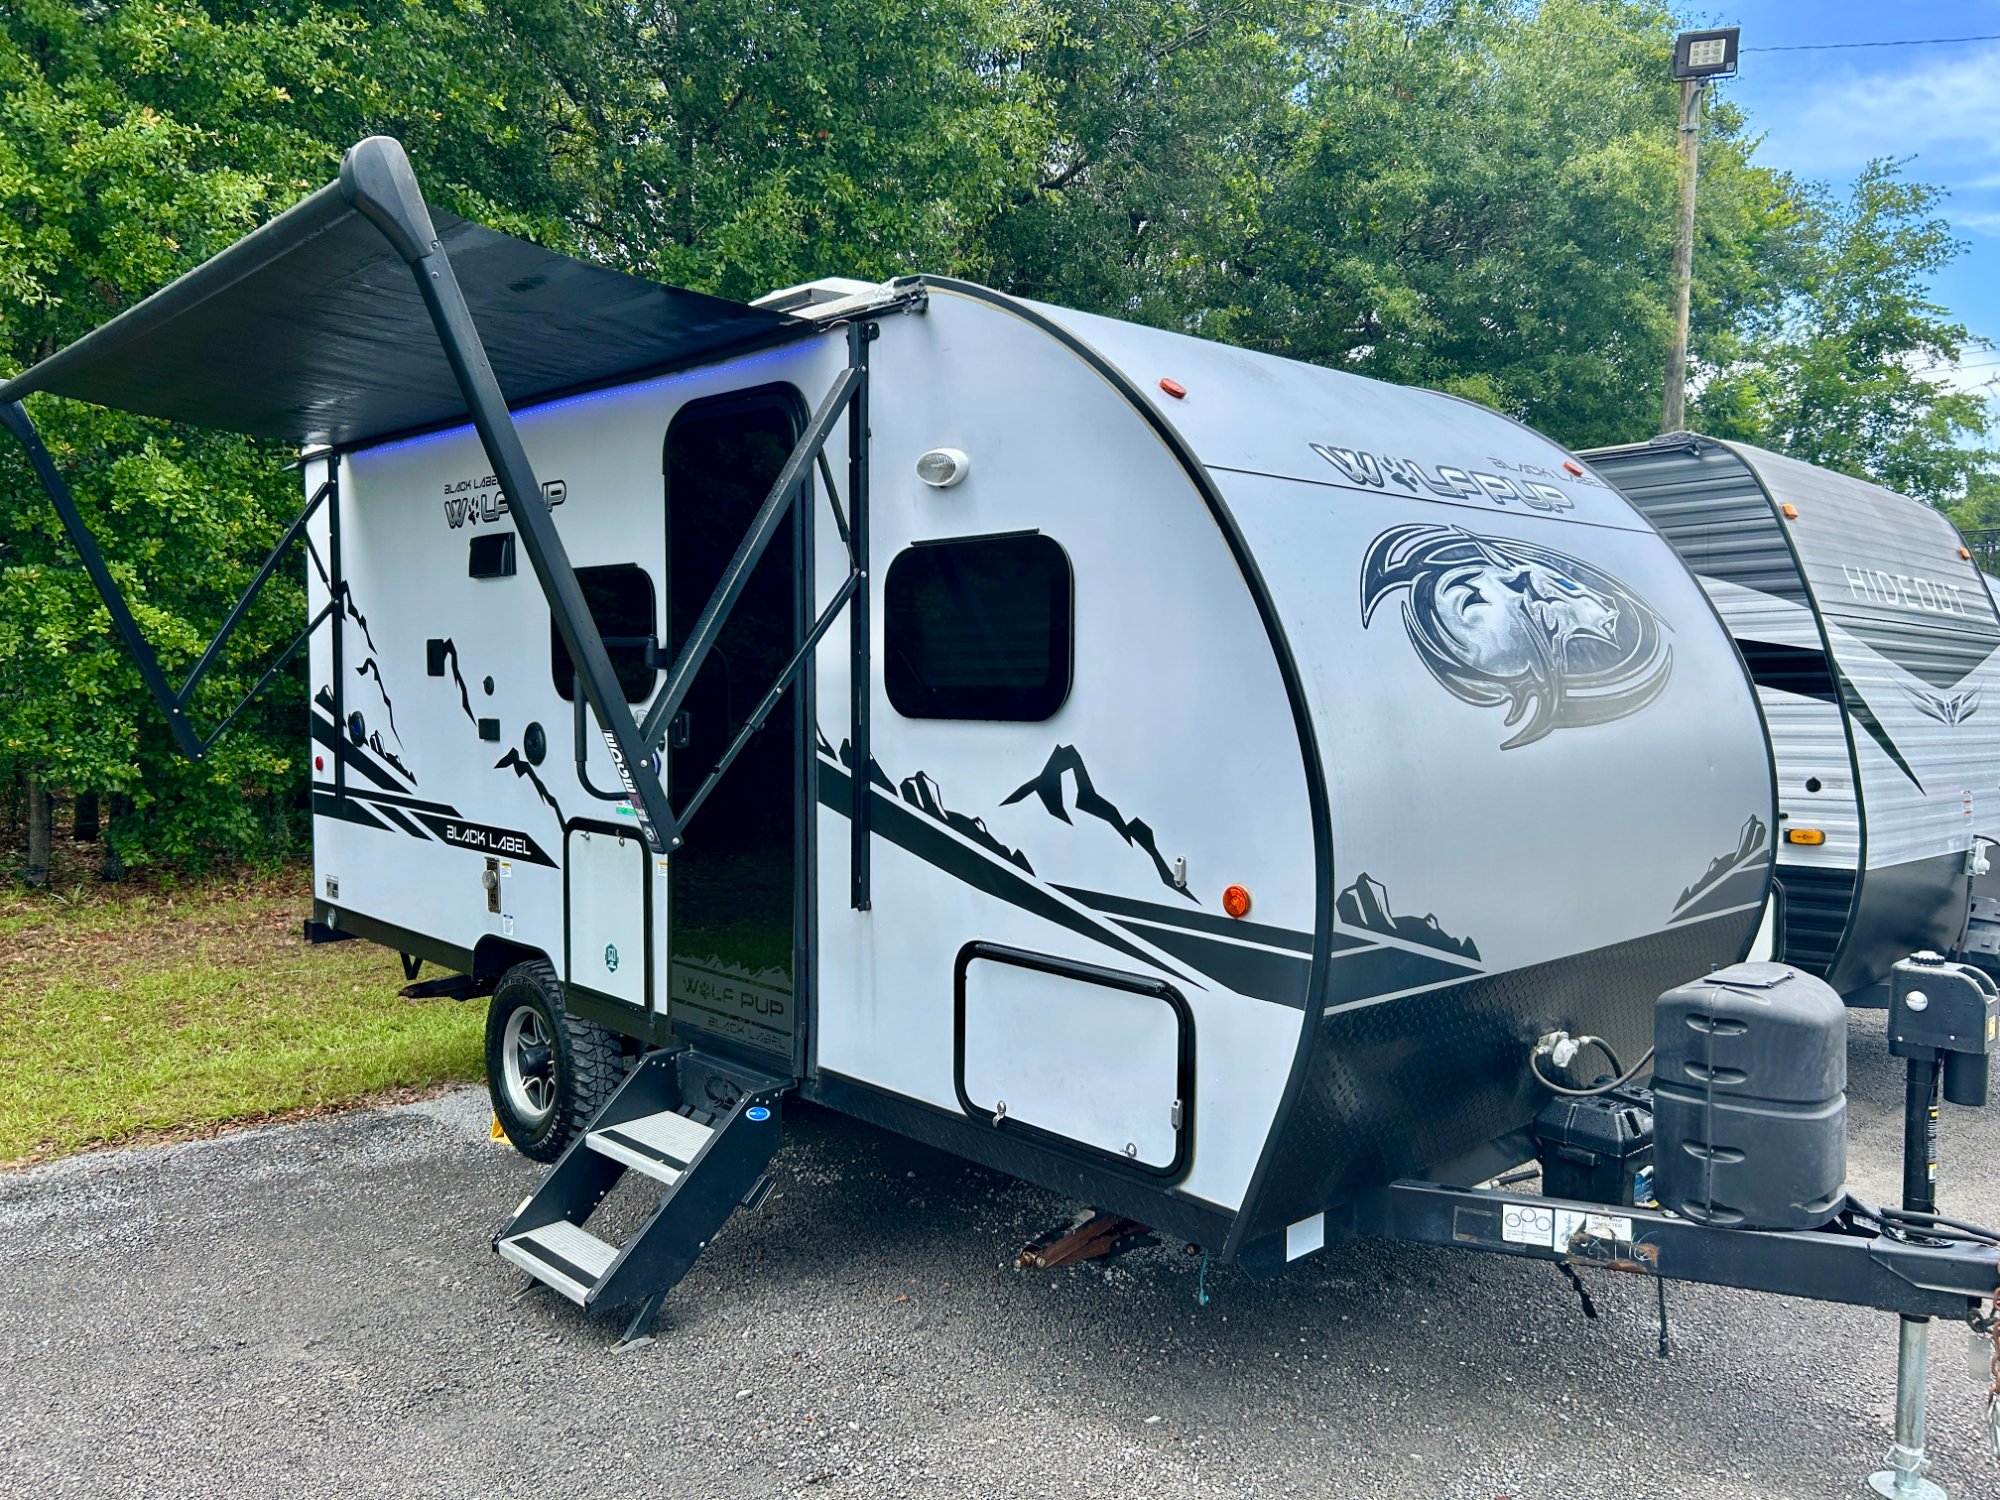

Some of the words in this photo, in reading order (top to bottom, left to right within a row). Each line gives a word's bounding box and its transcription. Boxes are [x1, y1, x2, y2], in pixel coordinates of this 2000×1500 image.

[1486, 456, 1555, 479] BLACK
[444, 480, 472, 495] BLACK
[474, 475, 498, 489] LABE
[1841, 563, 1967, 616] HIDEOUT
[446, 824, 486, 846] BLACK
[489, 832, 532, 856] LABEL
[740, 991, 784, 1017] PUP
[708, 1016, 745, 1034] BLACK
[748, 1028, 785, 1049] LABEL
